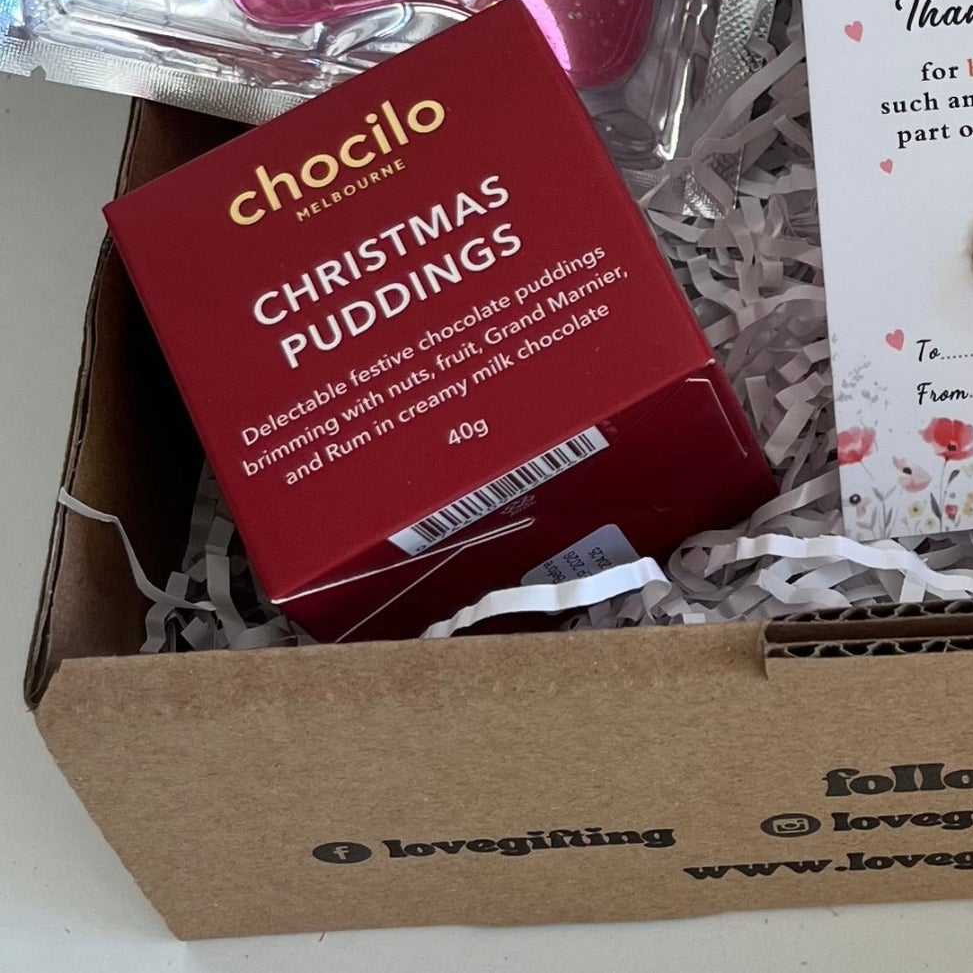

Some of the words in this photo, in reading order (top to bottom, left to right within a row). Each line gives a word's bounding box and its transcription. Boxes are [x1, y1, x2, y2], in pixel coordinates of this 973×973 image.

[880, 92, 940, 115] such
[920, 61, 960, 82] for
[229, 99, 446, 226] chocilo
[896, 122, 951, 149] part
[296, 158, 406, 222] MELBOURNE
[253, 175, 510, 326] CHRISTMAS
[280, 223, 523, 369] PUDDINGS
[241, 382, 348, 446] Delectable
[349, 347, 415, 387] festive
[418, 296, 511, 351] chocolate
[514, 246, 606, 305] puddings
[242, 417, 341, 477] brimming
[341, 391, 385, 422] with
[387, 368, 436, 398] nuts,
[435, 341, 483, 371] fruit,
[484, 303, 546, 345] Grand
[546, 266, 629, 313] Marnier,
[285, 452, 324, 485] and
[324, 430, 372, 462] Rum
[373, 418, 395, 436] in
[398, 378, 468, 423] creamy
[471, 353, 515, 384] milk
[516, 304, 610, 360] chocolate
[448, 418, 489, 445] 40g
[382, 826, 677, 860] lovegifting
